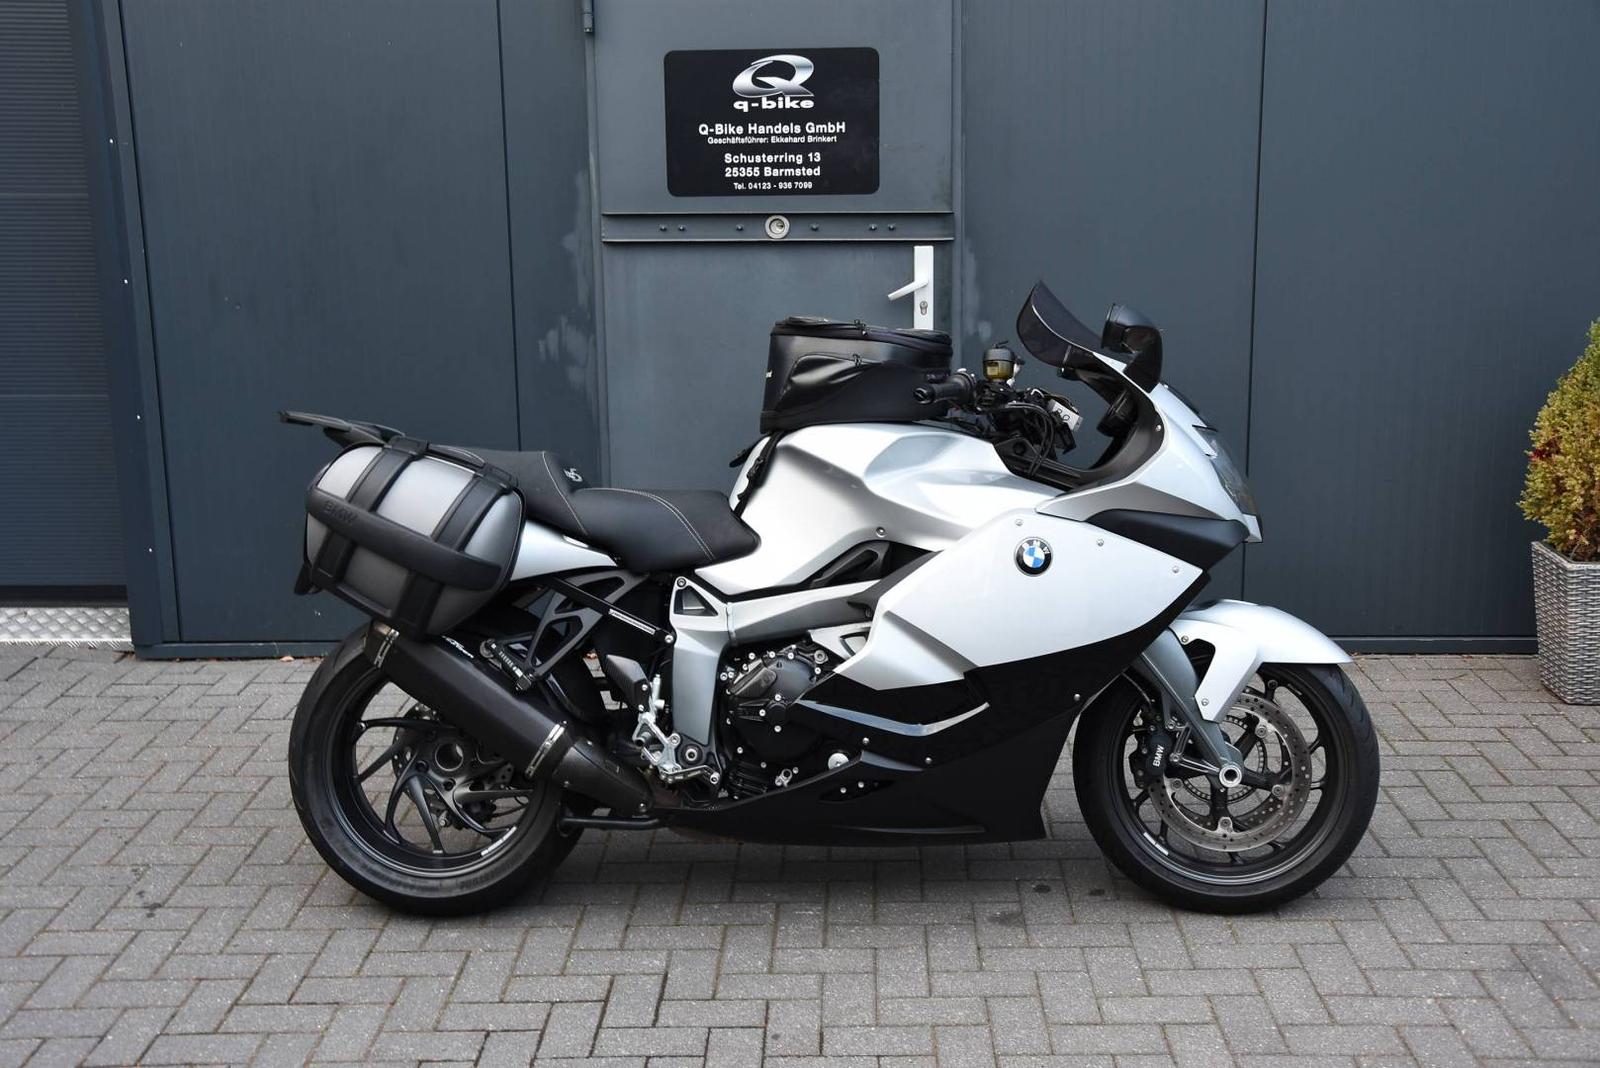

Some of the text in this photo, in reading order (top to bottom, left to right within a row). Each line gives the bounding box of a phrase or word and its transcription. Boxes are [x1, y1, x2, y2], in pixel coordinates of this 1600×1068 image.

[733, 96, 815, 113] q-bike
[698, 121, 846, 136] Q-Bike Handels GmbH
[707, 134, 837, 145] Geschäftsführer: Ekkehard Brinkert
[724, 152, 821, 165] Schusterring 13
[724, 166, 821, 177] 25355 Barmsted
[733, 182, 746, 190] Tel.
[748, 182, 771, 190] 04123
[794, 181, 813, 189] 7099
[1152, 744, 1165, 767] BMW
